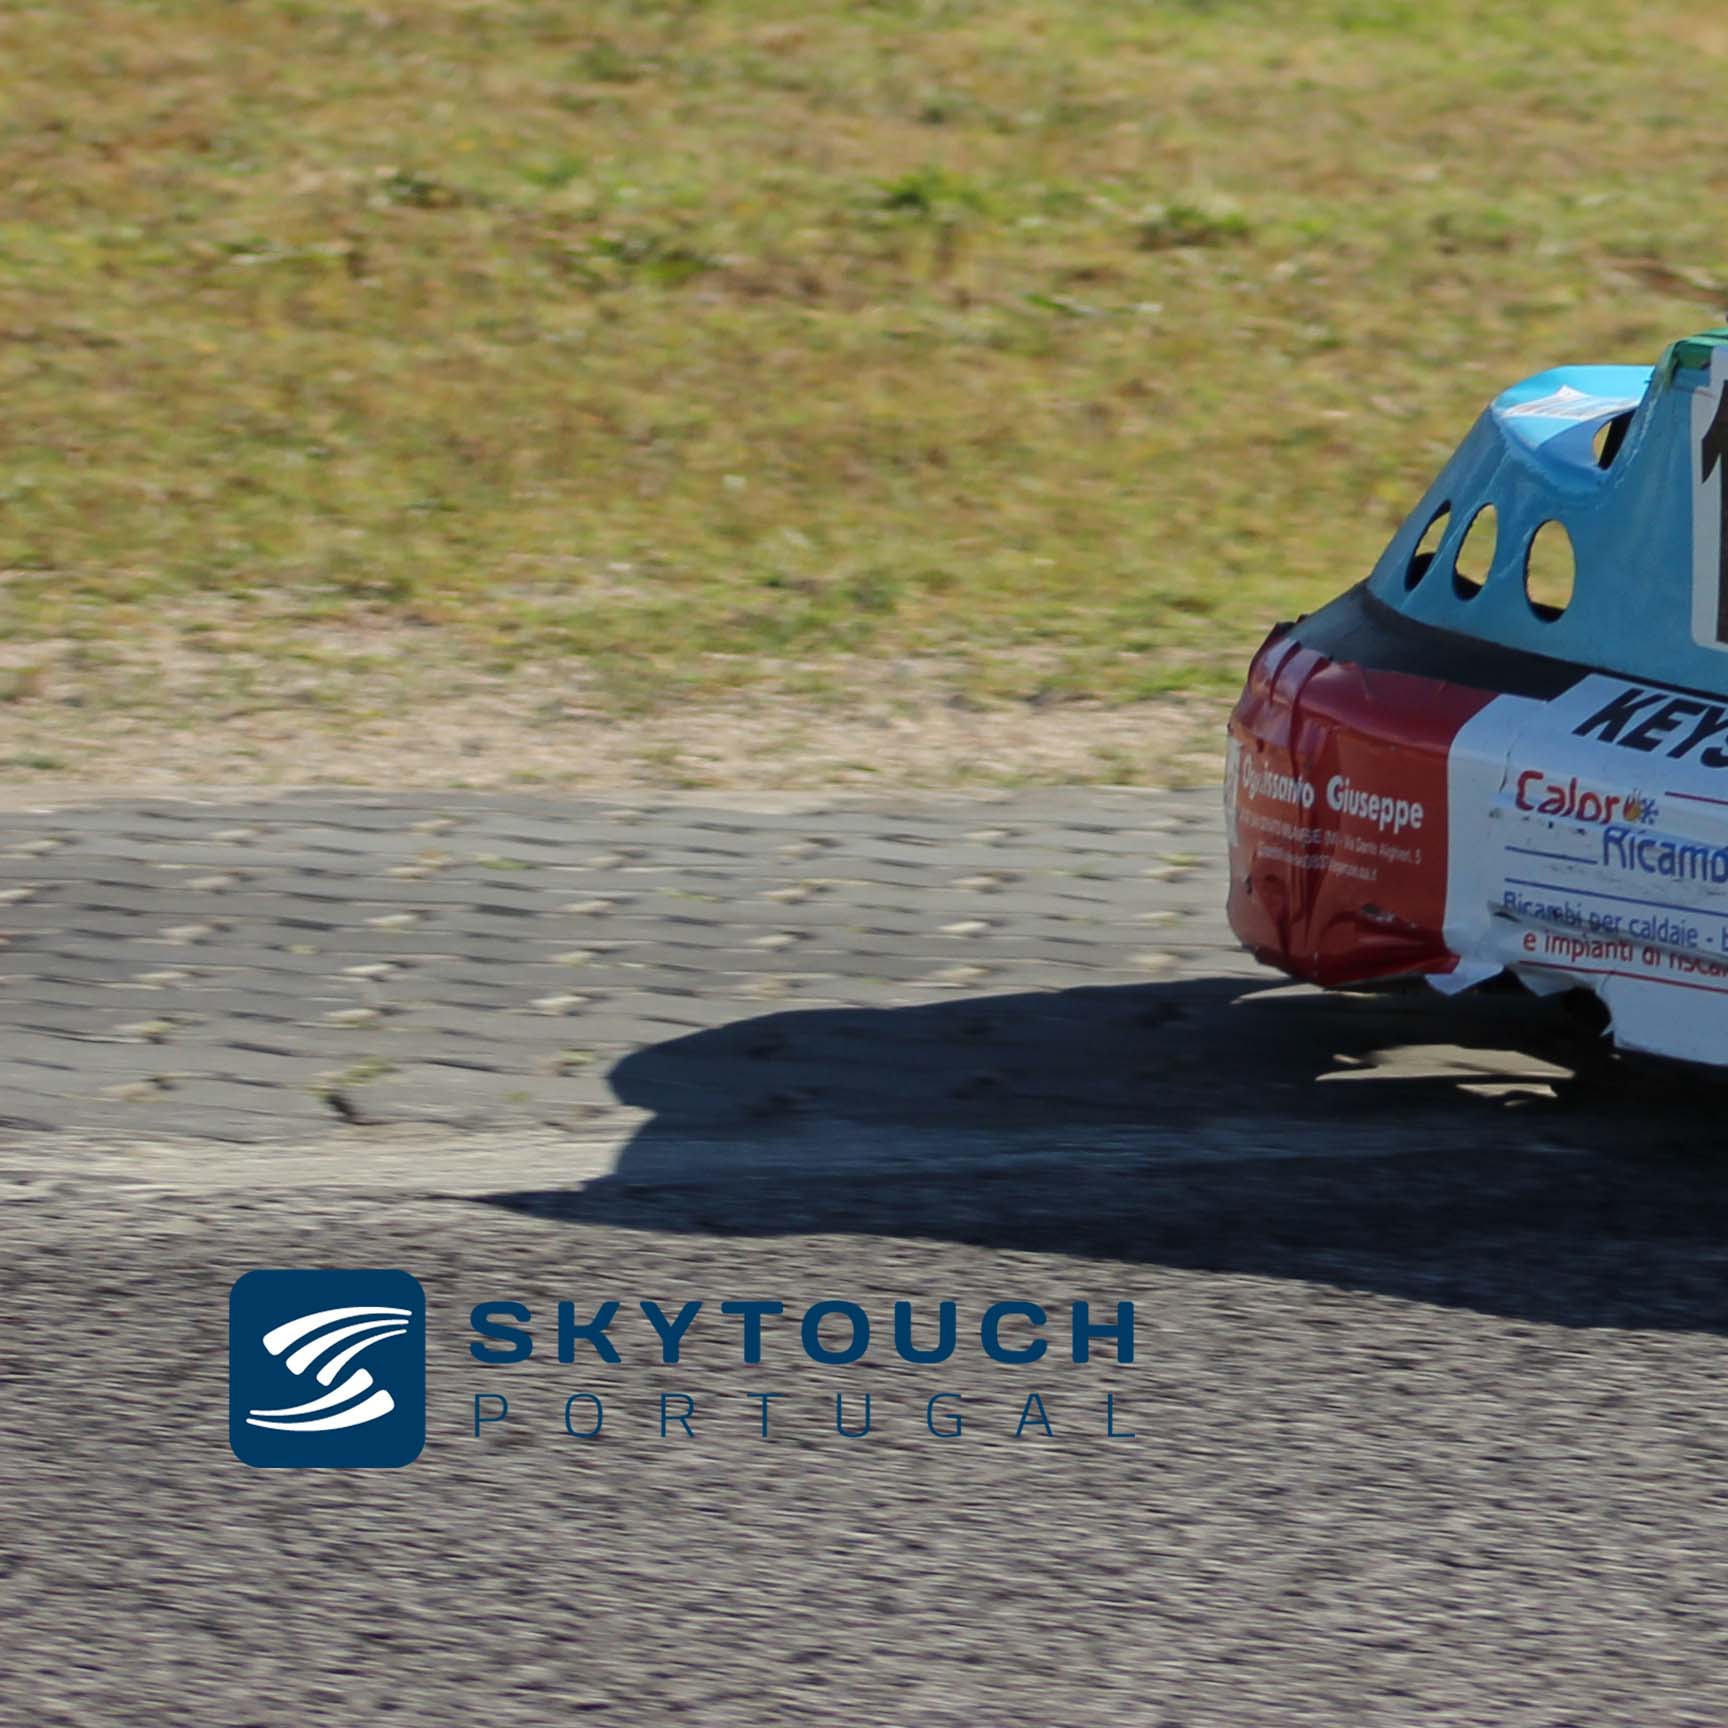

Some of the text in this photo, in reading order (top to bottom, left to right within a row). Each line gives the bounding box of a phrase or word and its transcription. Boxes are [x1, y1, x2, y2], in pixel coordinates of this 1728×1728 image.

[1327, 774, 1424, 835] Giuseppe
[1515, 770, 1620, 824] Calor
[1523, 931, 1537, 952] e
[1544, 932, 1635, 964] impianti
[1628, 913, 1699, 949] caldaie
